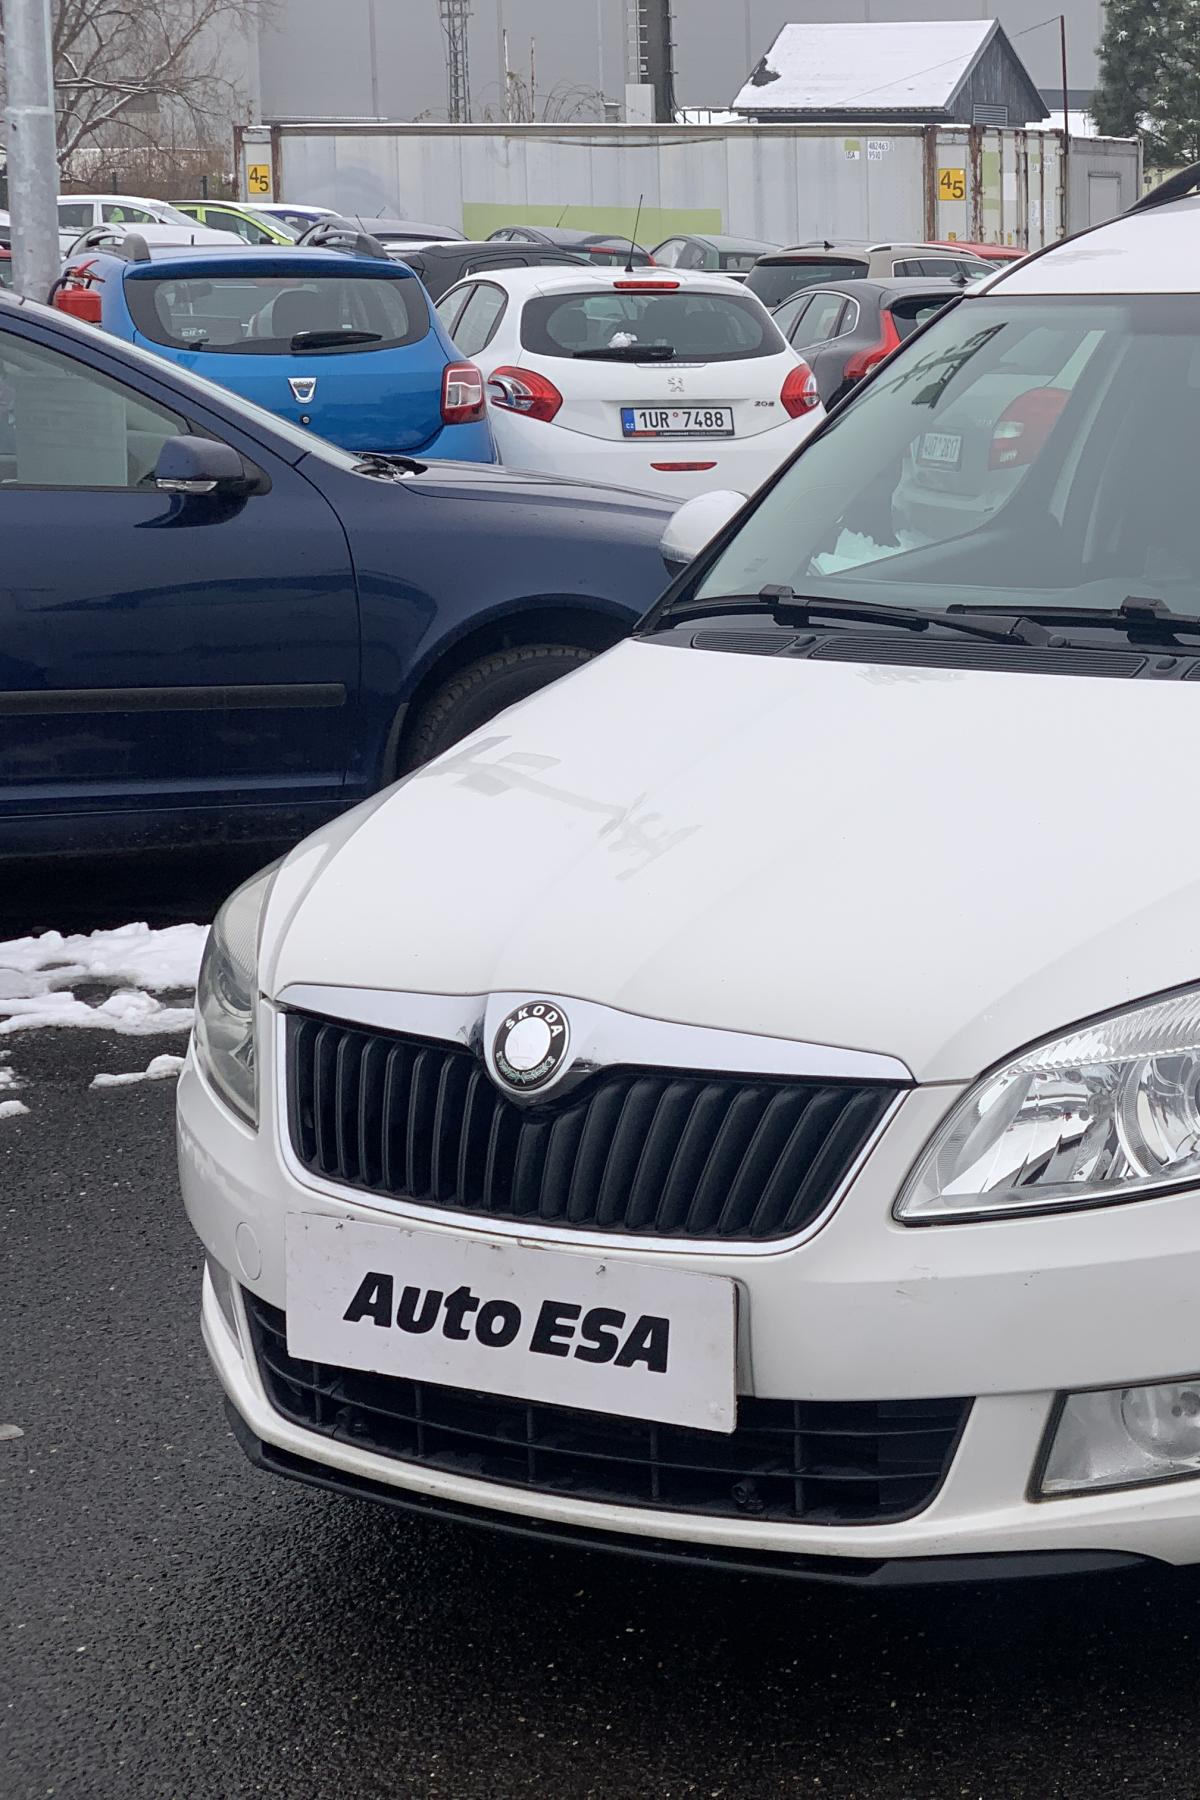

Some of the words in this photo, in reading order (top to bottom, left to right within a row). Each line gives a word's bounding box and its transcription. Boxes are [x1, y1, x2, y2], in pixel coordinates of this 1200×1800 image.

[249, 167, 269, 192] 45
[940, 171, 964, 199] 45
[639, 411, 670, 429] 1UR
[682, 411, 724, 428] 7488
[342, 1271, 522, 1348] Auto
[528, 1299, 670, 1374] ESA
